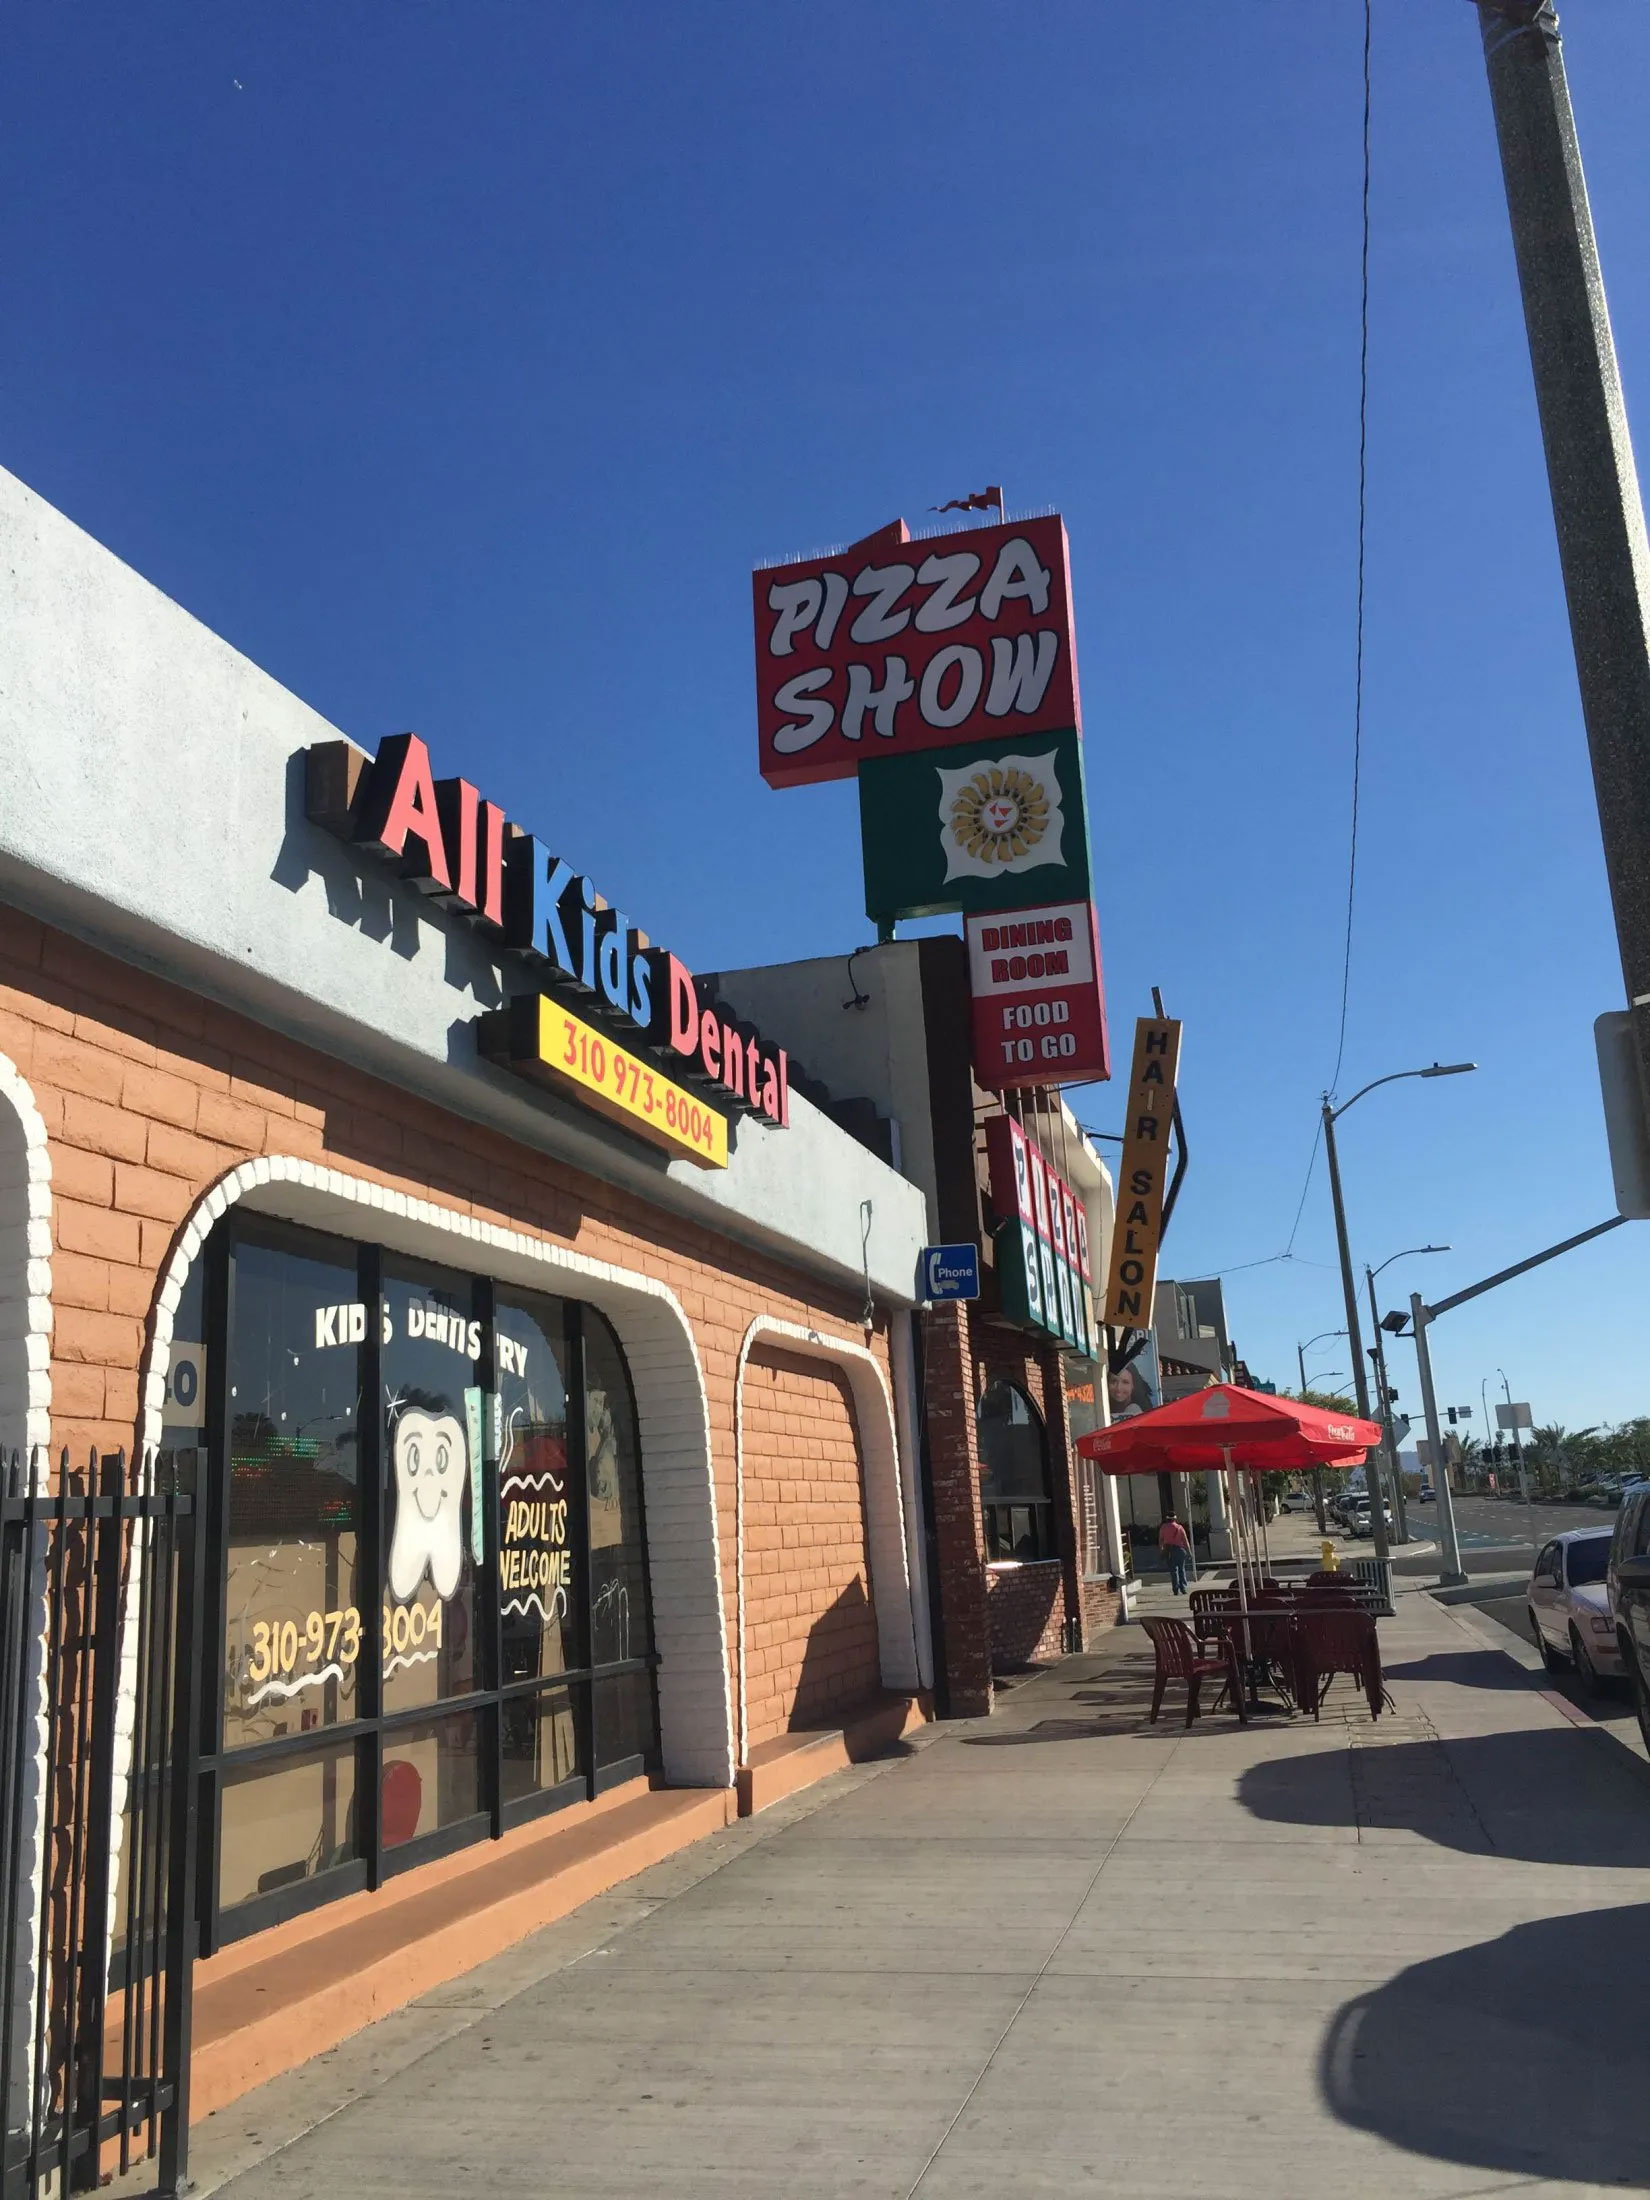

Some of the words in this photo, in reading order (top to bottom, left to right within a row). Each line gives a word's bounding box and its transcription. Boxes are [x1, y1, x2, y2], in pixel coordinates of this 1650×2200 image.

[768, 536, 1051, 656] PIZZA
[772, 630, 1059, 753] SHOW
[380, 733, 506, 928] All
[531, 834, 651, 1028] Kids
[670, 952, 790, 1128] Dental
[981, 917, 1073, 952] DINING
[991, 950, 1070, 983] ROOM
[1000, 1038, 1034, 1064] TO
[1041, 1033, 1076, 1059] GO
[1002, 1000, 1070, 1030] FOOD
[563, 1020, 606, 1083] 310
[613, 1054, 713, 1151] 973-8004
[1136, 1030, 1169, 1142] HAIR
[1015, 1146, 1088, 1259] PIZZA
[1117, 1170, 1153, 1317] SALON
[938, 1268, 973, 1278] Phone
[408, 1297, 529, 1378] DENTISRY
[505, 1499, 568, 1545] ADULTS
